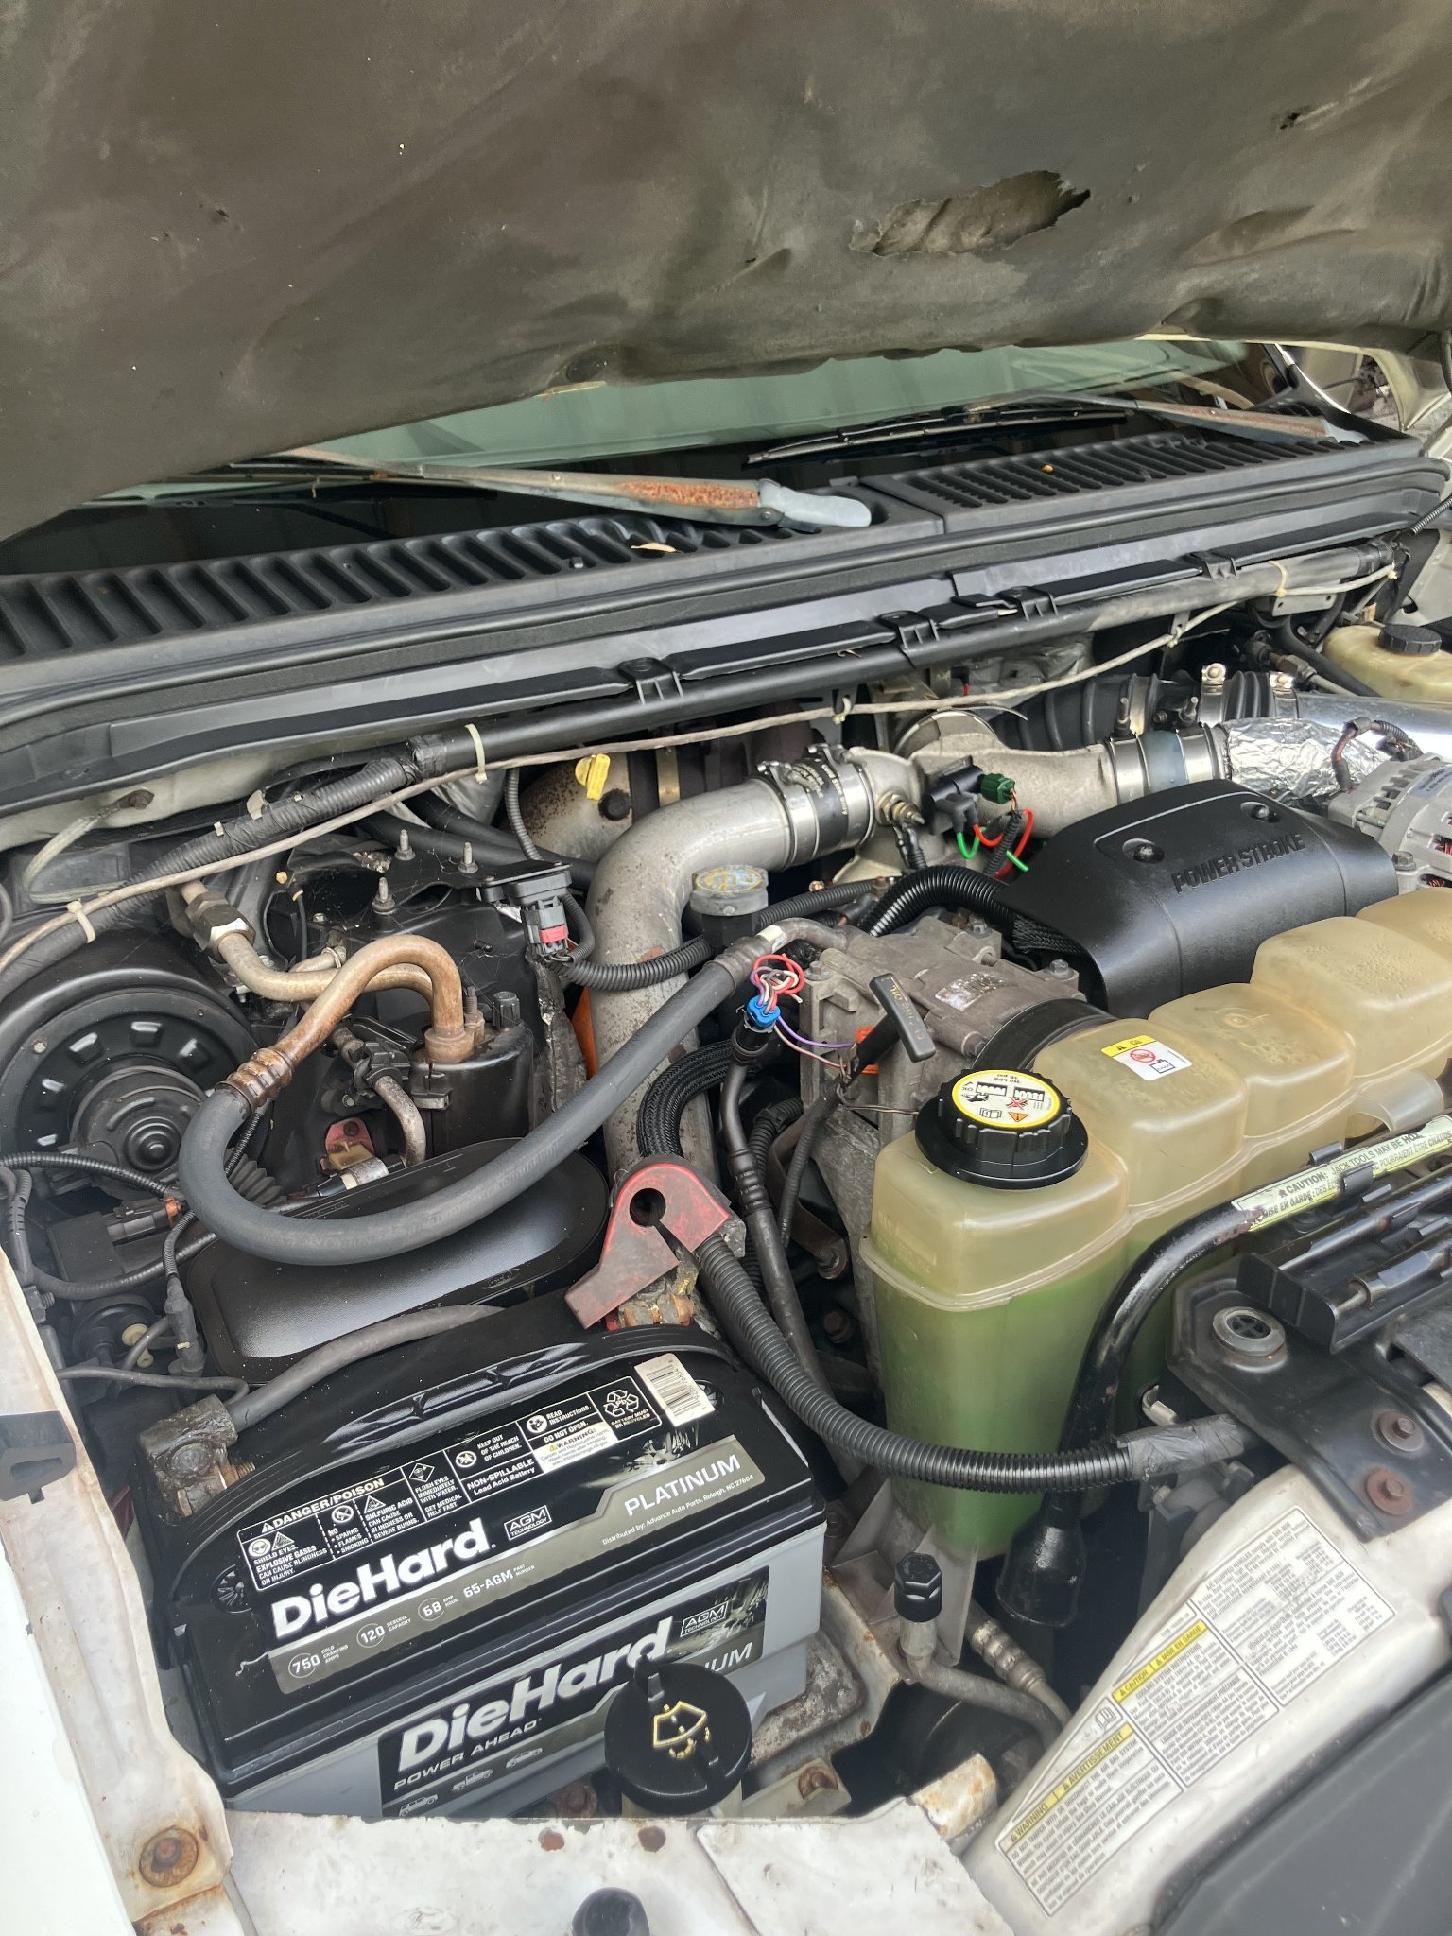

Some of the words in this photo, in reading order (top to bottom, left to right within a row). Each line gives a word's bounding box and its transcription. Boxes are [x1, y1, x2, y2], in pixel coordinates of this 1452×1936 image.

[1286, 1171, 1328, 1193] CAUTION:
[1348, 1151, 1375, 1167] TOOLS
[1374, 1145, 1390, 1155] MAY
[1391, 1140, 1401, 1148] BE
[545, 1409, 563, 1419] READ
[553, 1428, 568, 1438] NOT
[466, 1457, 534, 1490] NON-SPILLABLE
[473, 1484, 489, 1495] Lead
[491, 1475, 510, 1487] Acid
[624, 1454, 741, 1517] PLATINUM
[272, 1477, 385, 1528] DANGER/POISON
[396, 1497, 413, 1508] ACID
[441, 1501, 456, 1511] FAST
[507, 1508, 546, 1531] AGM
[601, 1525, 636, 1546] Distributed
[256, 1552, 293, 1573] EXPLOSIVE
[272, 1521, 490, 1639] DieHard
[463, 1568, 513, 1599] 65-AGM
[421, 1599, 442, 1618] 68
[684, 1603, 724, 1629] AGM
[360, 1623, 386, 1645] 120
[292, 1652, 320, 1676] 750
[1123, 1668, 1150, 1691] CAUTION
[398, 1616, 673, 1772] DieHard
[393, 1751, 463, 1790] POWER
[471, 1719, 536, 1756] AHEAD
[1066, 1732, 1124, 1785] AVERTISSEMENT
[1013, 1802, 1050, 1837] WARNING
